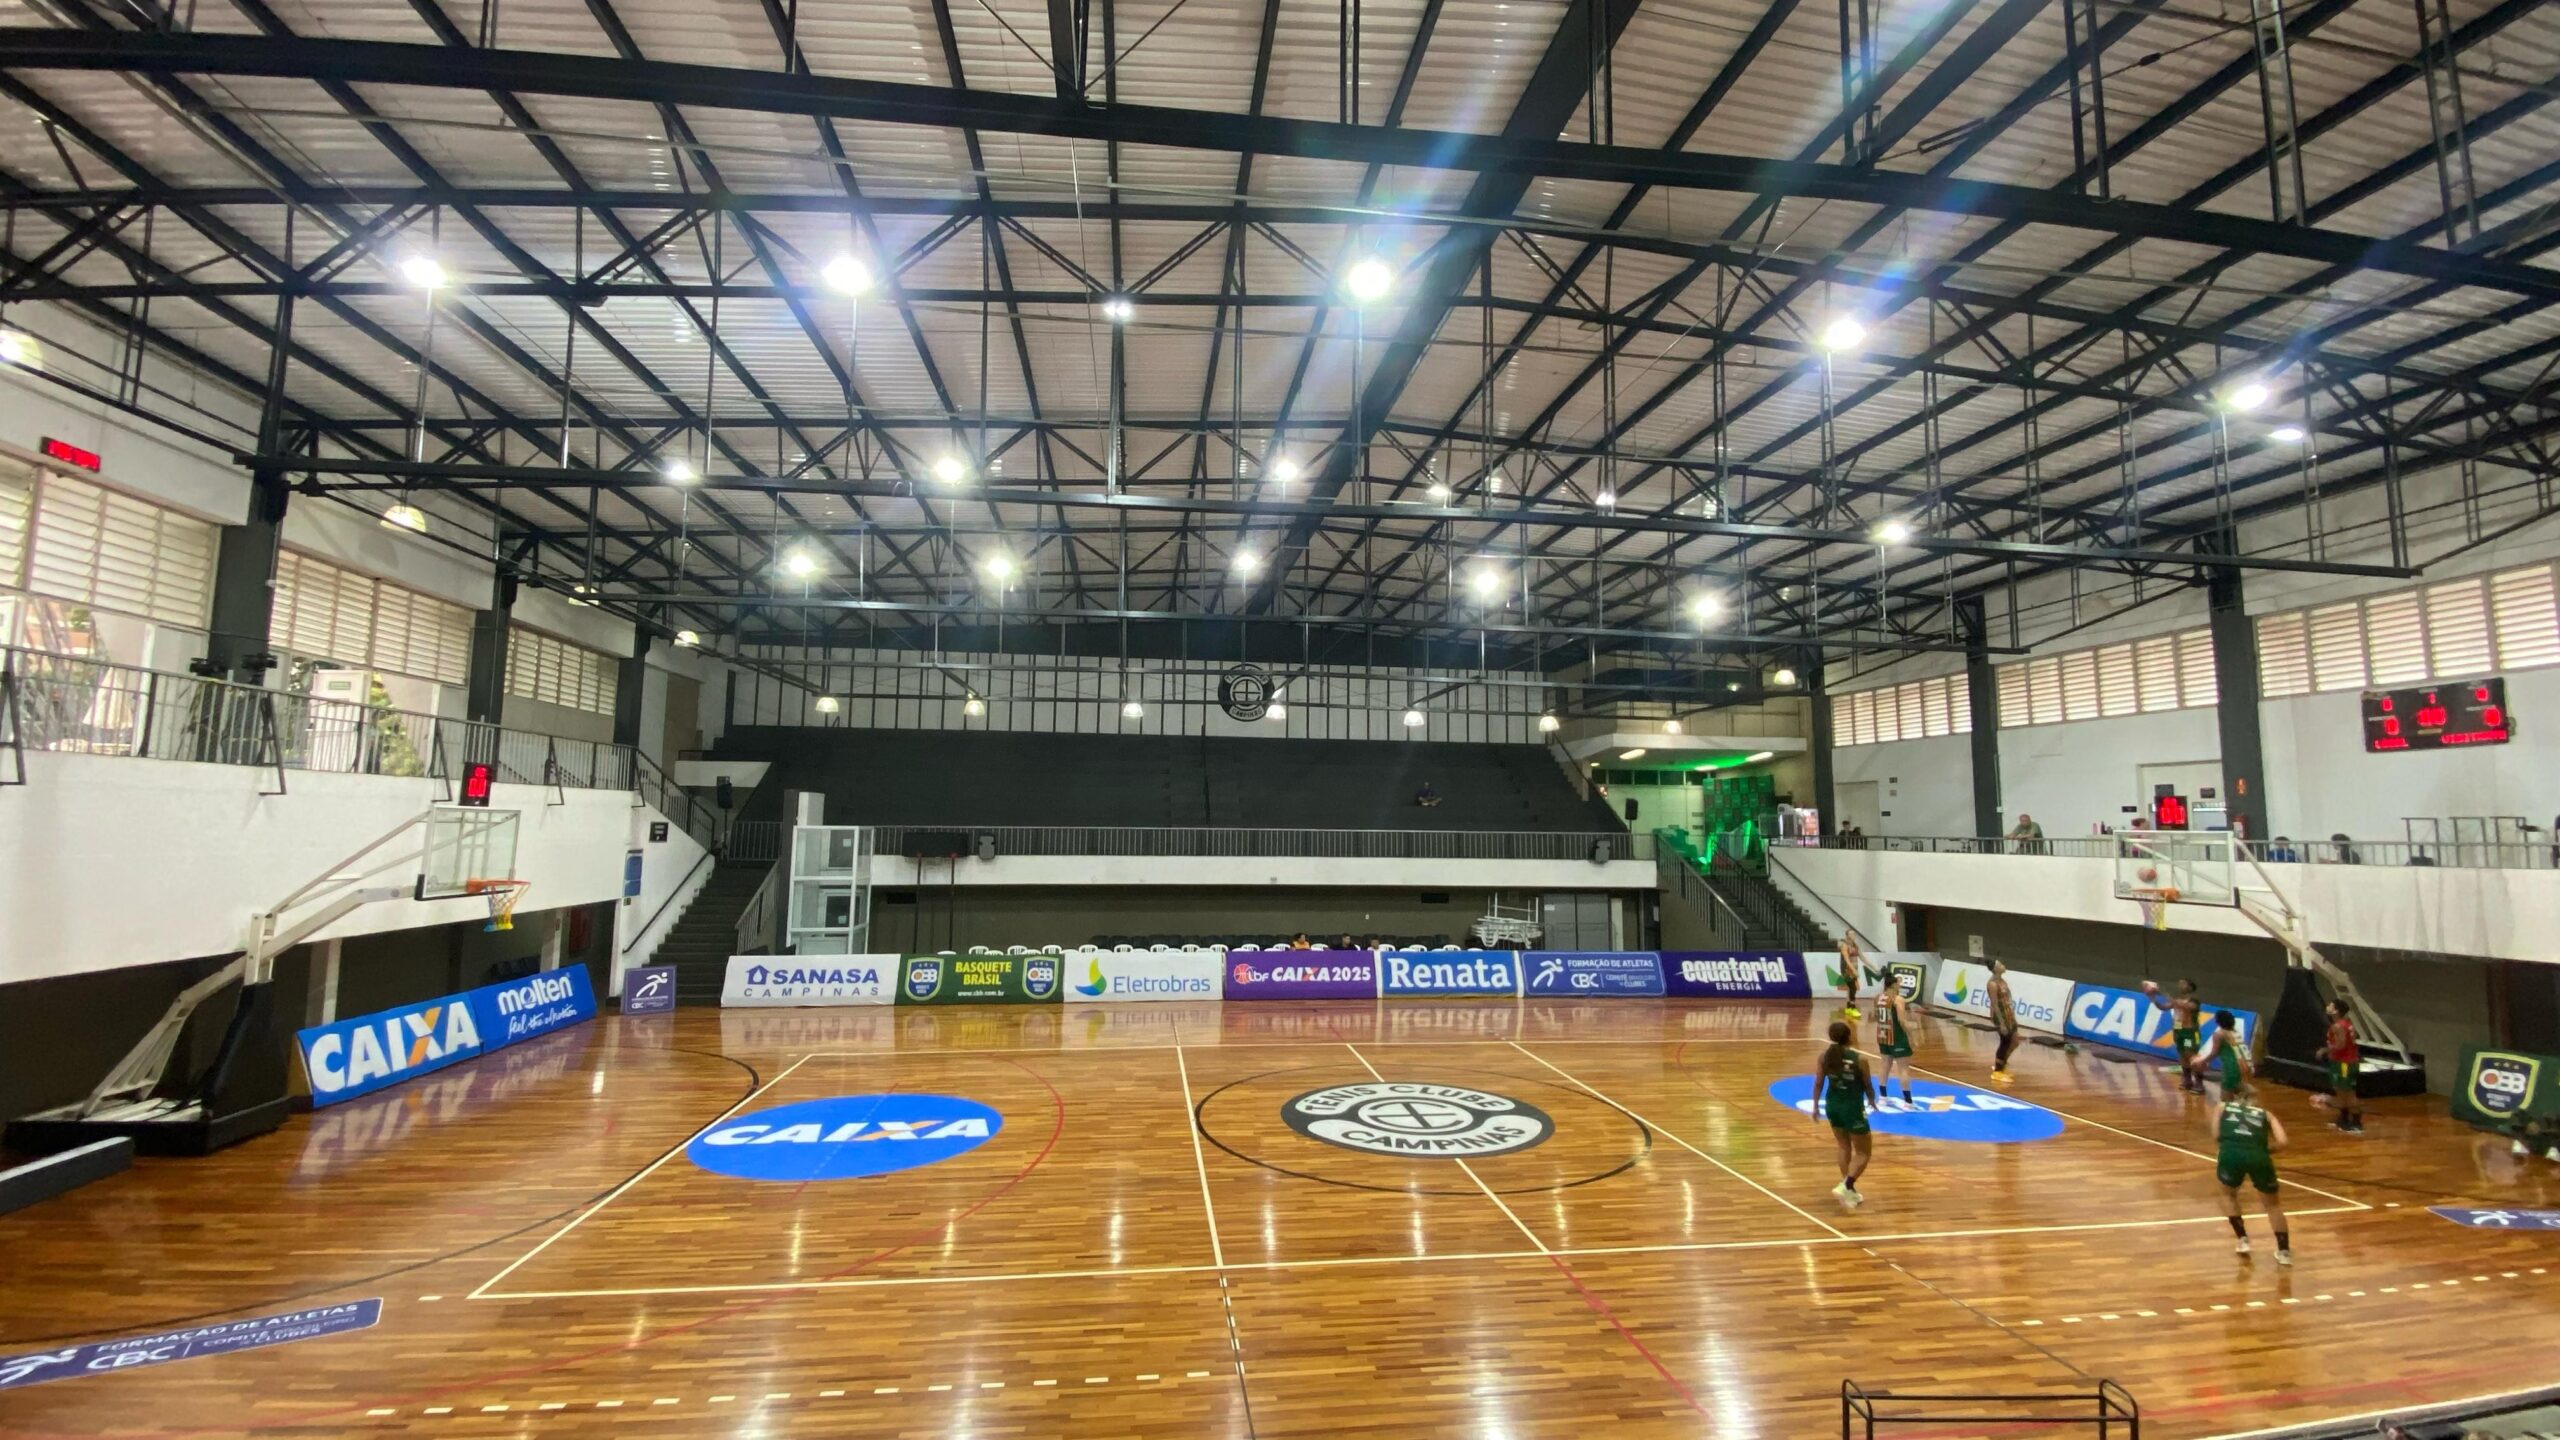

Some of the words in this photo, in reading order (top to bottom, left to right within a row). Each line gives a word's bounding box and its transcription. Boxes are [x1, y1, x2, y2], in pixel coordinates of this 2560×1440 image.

[955, 961, 1012, 975] BASQUETE
[1271, 966, 1331, 982] CAIXA
[1332, 966, 1371, 982] 2025
[1388, 957, 1511, 988] Renata
[1567, 958, 1610, 969] FORMAÇÃO
[1681, 956, 1788, 983] equatorial
[772, 968, 879, 985] SANASA
[963, 973, 1002, 985] BRASIL
[1113, 975, 1211, 993] Eletrobras
[1571, 973, 1599, 988] CBC
[1716, 982, 1762, 992] ENERGIA
[498, 976, 573, 1015] molten
[744, 986, 879, 998] CAMPINAS
[309, 1001, 480, 1092] CAIXA
[1304, 1086, 1377, 1111] TÊNIS
[1388, 1085, 1504, 1108] CLUBE
[703, 1118, 989, 1145] CAIXA
[1341, 1125, 1526, 1150] CAMPINAS
[97, 1325, 227, 1352] FORMAÇÃO
[232, 1321, 261, 1332] DE
[265, 1304, 358, 1327] ATLETAS
[85, 1345, 176, 1369] CBC
